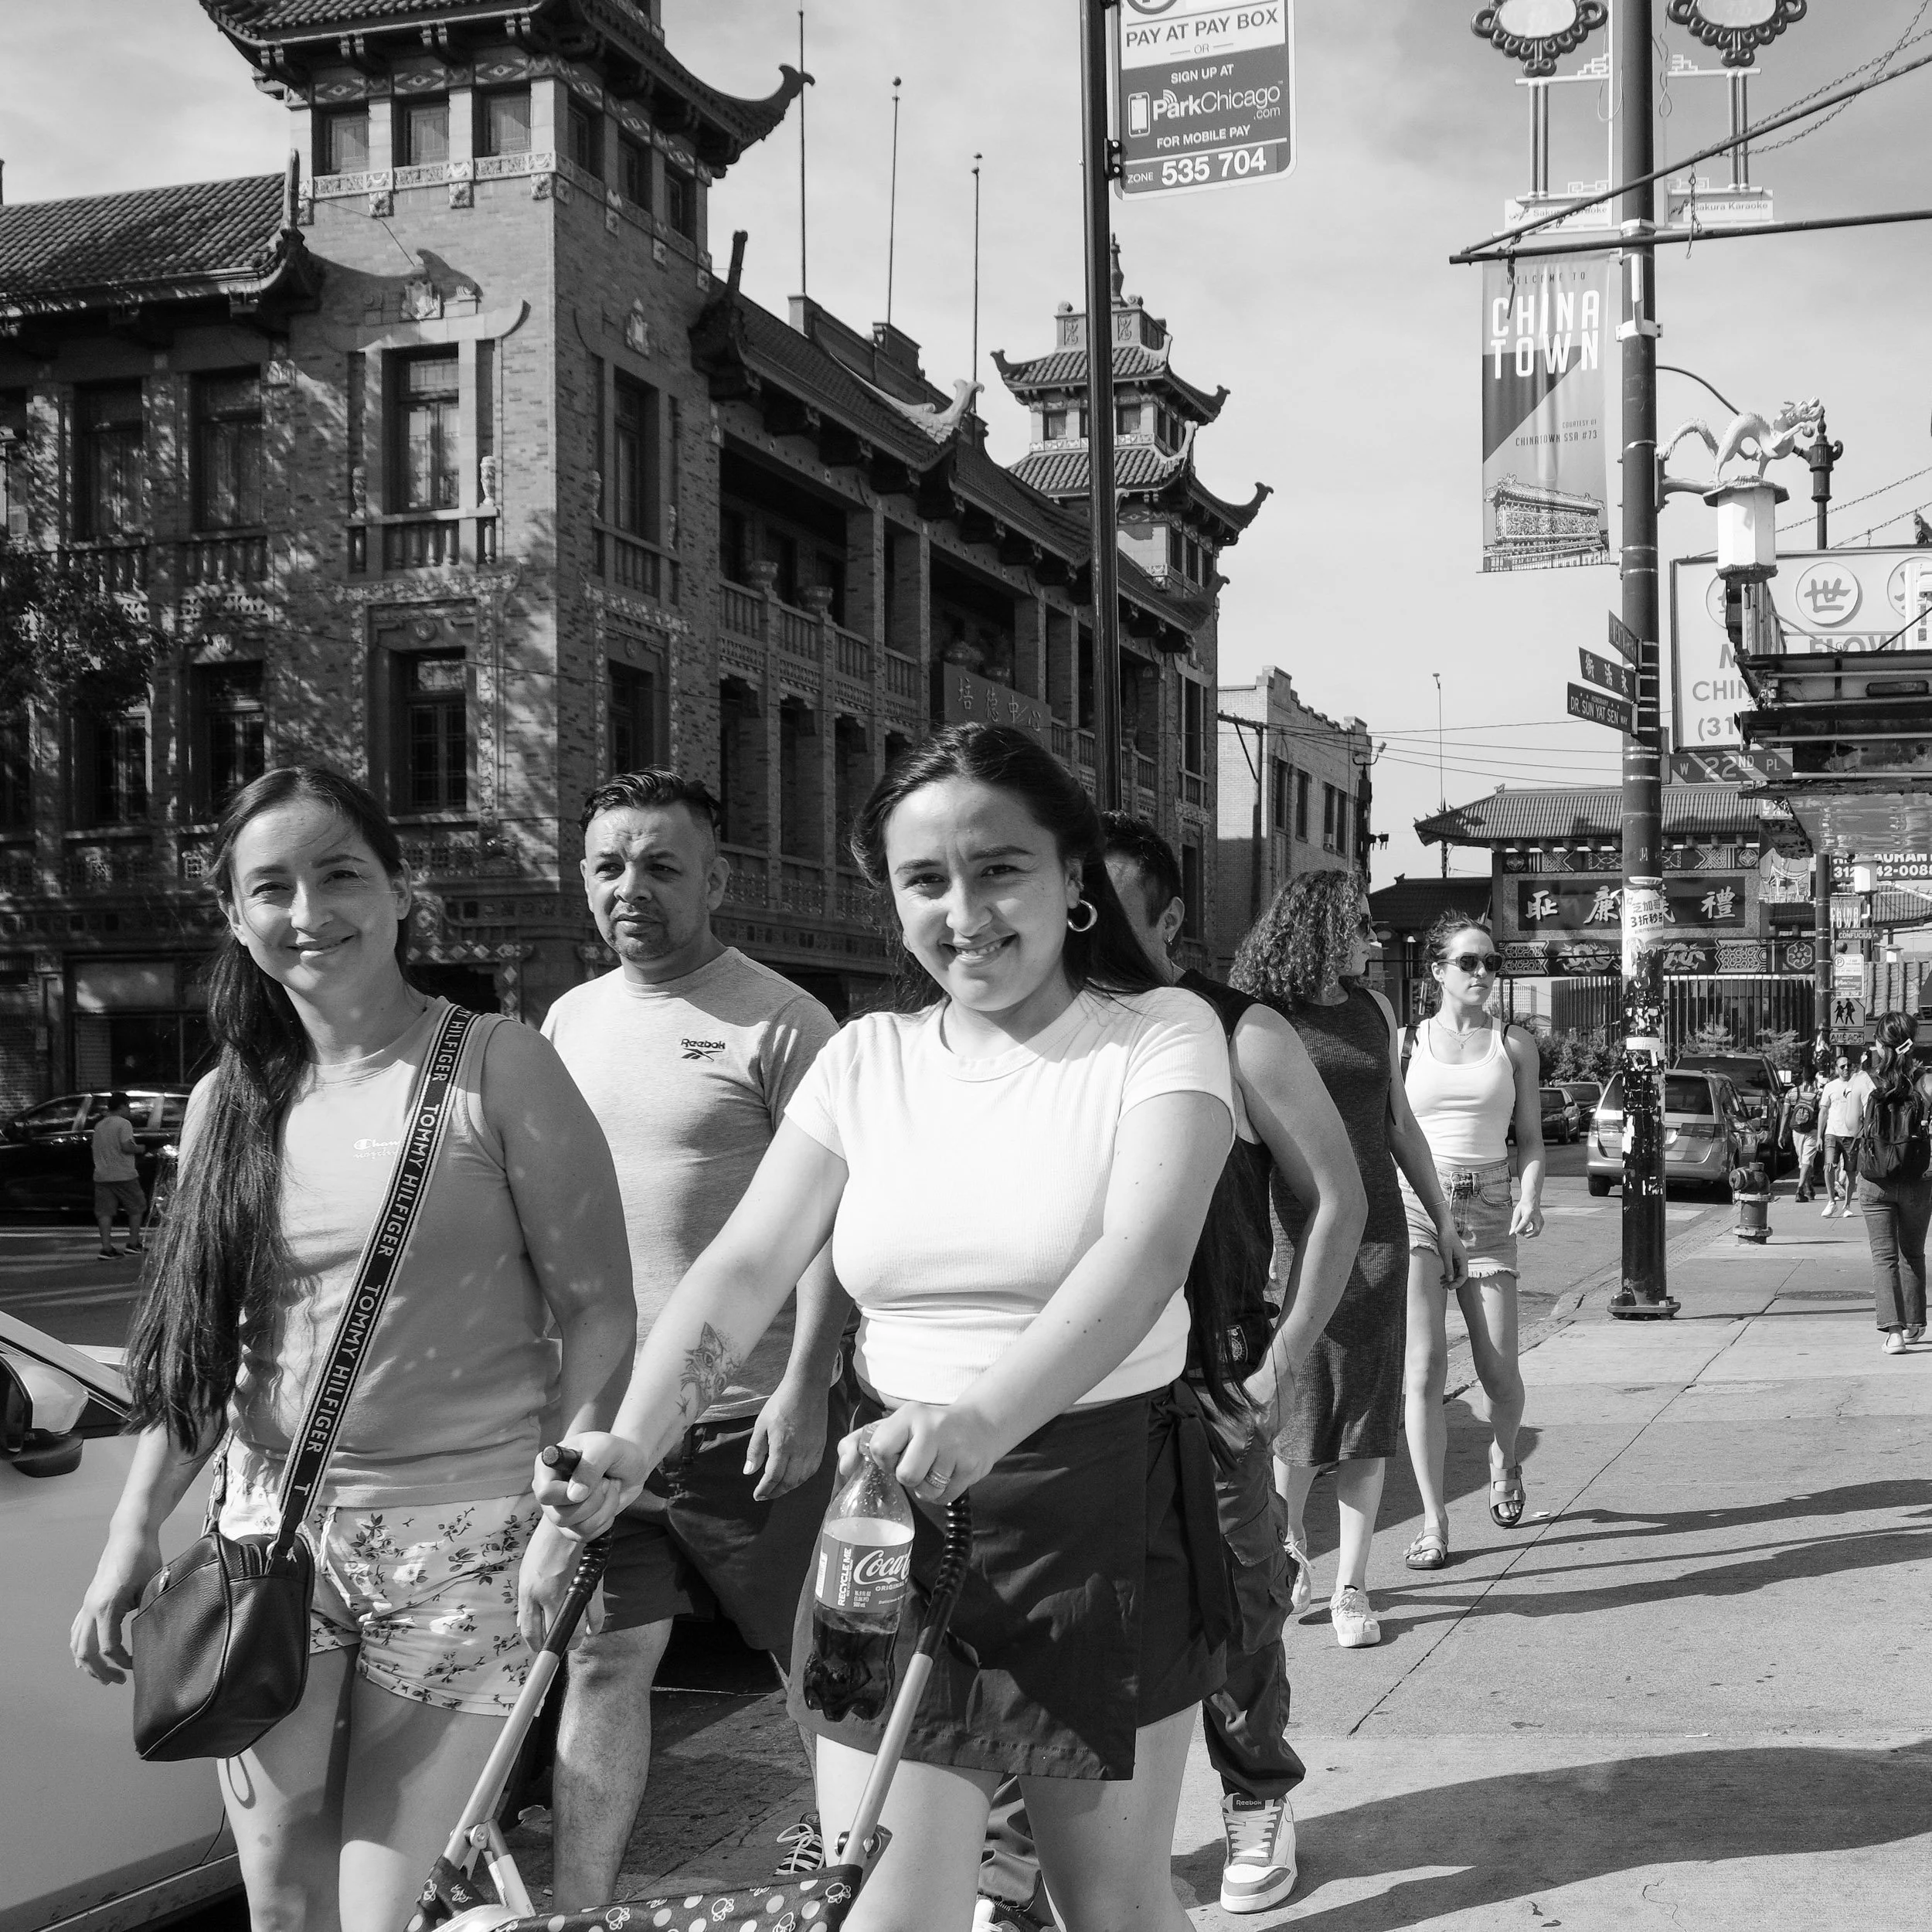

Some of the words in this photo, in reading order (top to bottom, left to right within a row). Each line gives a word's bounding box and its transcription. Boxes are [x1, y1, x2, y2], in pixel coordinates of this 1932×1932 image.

[1126, 28, 1161, 47] PAY
[1166, 23, 1189, 41] AT
[1196, 16, 1230, 37] PAY
[1237, 9, 1278, 29] BOX
[1194, 43, 1210, 55] OR
[1171, 70, 1199, 84] SIGN
[1201, 66, 1217, 79] UP
[1219, 64, 1234, 76] AT
[1153, 85, 1281, 121] ParkChicago
[1253, 106, 1281, 120] .com
[1156, 136, 1180, 149] FOR
[1182, 128, 1226, 145] MOBILE
[1229, 124, 1251, 137] PAY
[1127, 172, 1154, 184] ZONE
[1161, 156, 1210, 186] 535
[1217, 147, 1267, 177] 704
[1532, 208, 1563, 218] Saku
[1728, 201, 1769, 210] Karaoke
[1573, 271, 1586, 281] TO
[1492, 290, 1600, 337] CHINA
[1490, 329, 1600, 380] TOWN
[1515, 433, 1560, 447] CHINATOWN
[1563, 431, 1579, 442] SSA
[1804, 577, 1852, 613] 世
[1809, 635, 1905, 653] FLOW
[957, 676, 1041, 732] 培德中心
[1570, 696, 1580, 713] DR.
[1582, 699, 1594, 717] SUN
[1595, 705, 1606, 721] YAT
[1607, 708, 1619, 725] SEN
[1679, 763, 1689, 775] W
[1766, 759, 1781, 771] PL
[1830, 906, 1859, 918] CHINA
[1830, 917, 1859, 928] TOWN
[432, 1020, 465, 1081] HILFIGER
[680, 1038, 726, 1049] Reebok
[408, 1104, 440, 1169] TOMMY
[377, 1173, 420, 1257] HILFIGER
[341, 1284, 382, 1359] TOMMY
[305, 1364, 351, 1454] HILFIGER
[842, 1547, 852, 1563] ME
[837, 1563, 850, 1607] RECYCLE
